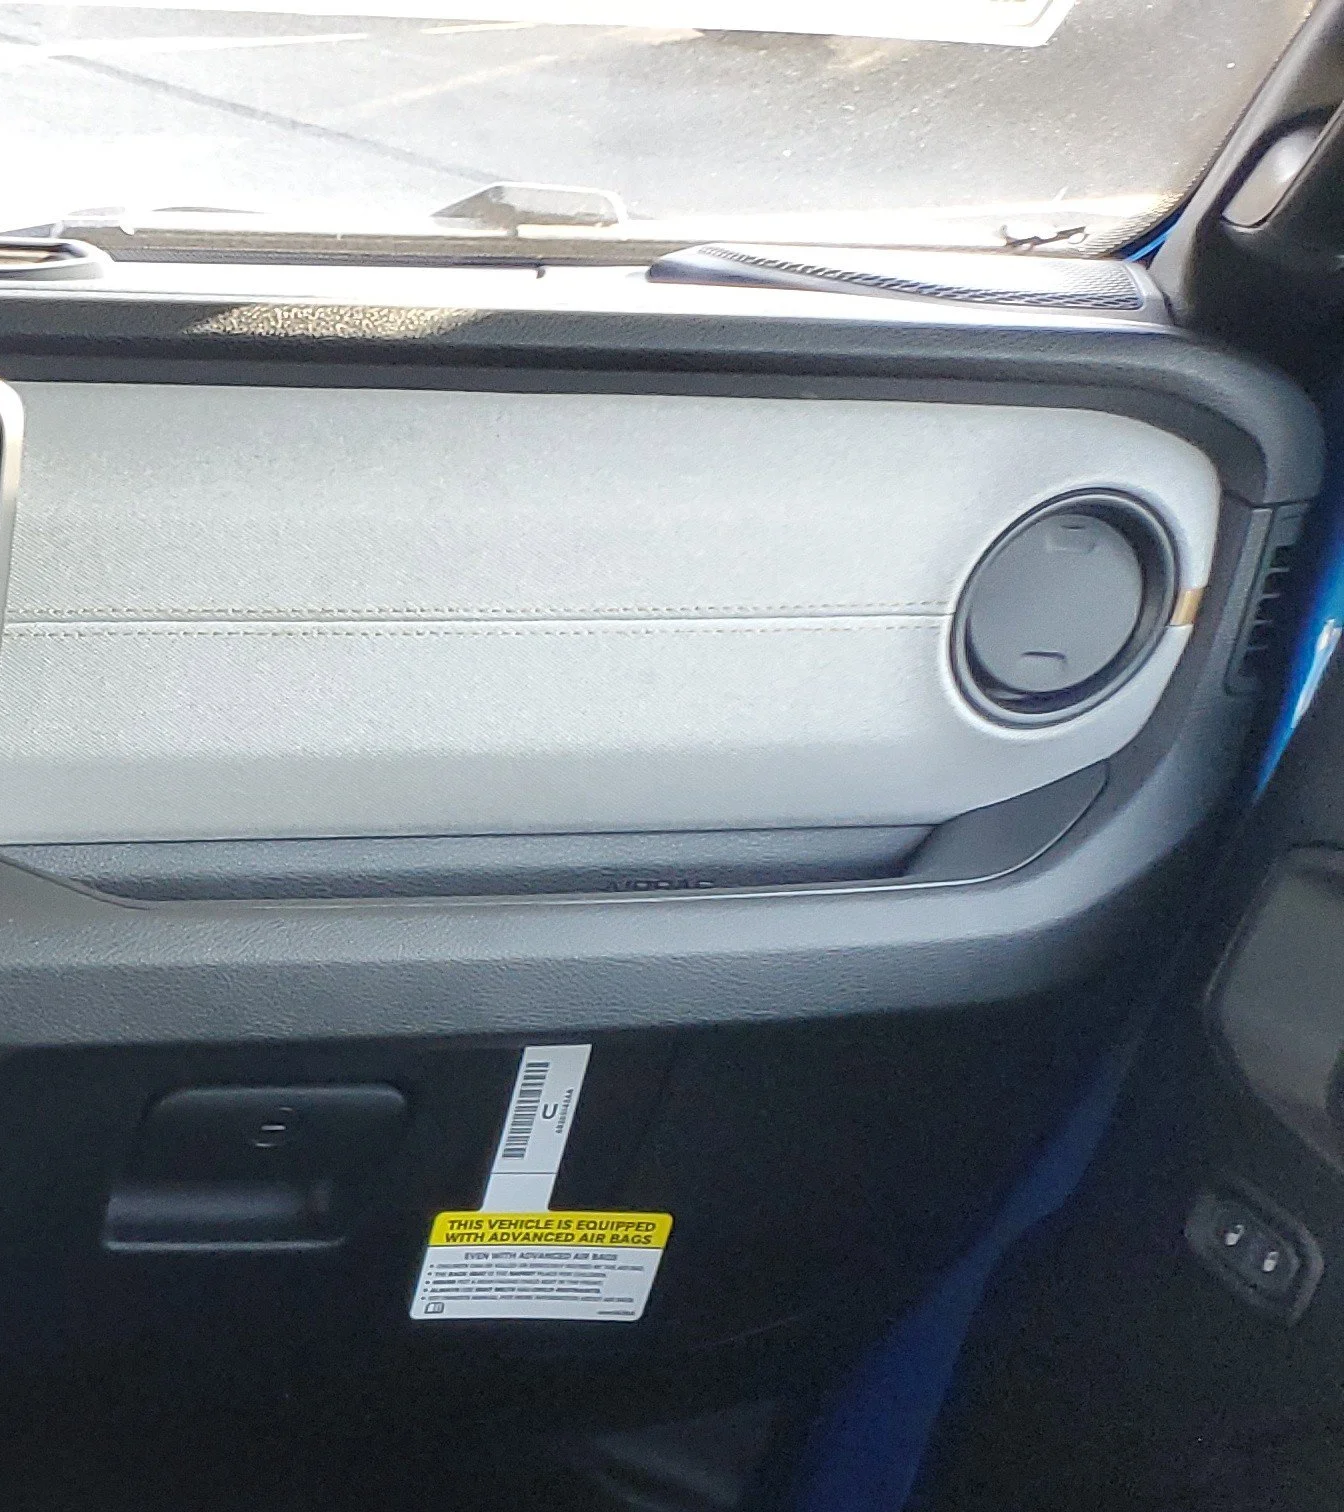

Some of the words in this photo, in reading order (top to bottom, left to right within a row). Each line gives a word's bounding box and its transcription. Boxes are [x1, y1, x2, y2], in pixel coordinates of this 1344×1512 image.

[447, 1219, 483, 1231] THIS
[487, 1219, 553, 1231] VEHICLE
[556, 1220, 573, 1231] IS
[576, 1220, 656, 1232] EQUIPPED
[445, 1232, 484, 1243] WITH
[488, 1232, 575, 1243] ADVANCED
[578, 1233, 605, 1244] AIR
[609, 1233, 653, 1245] BAGS
